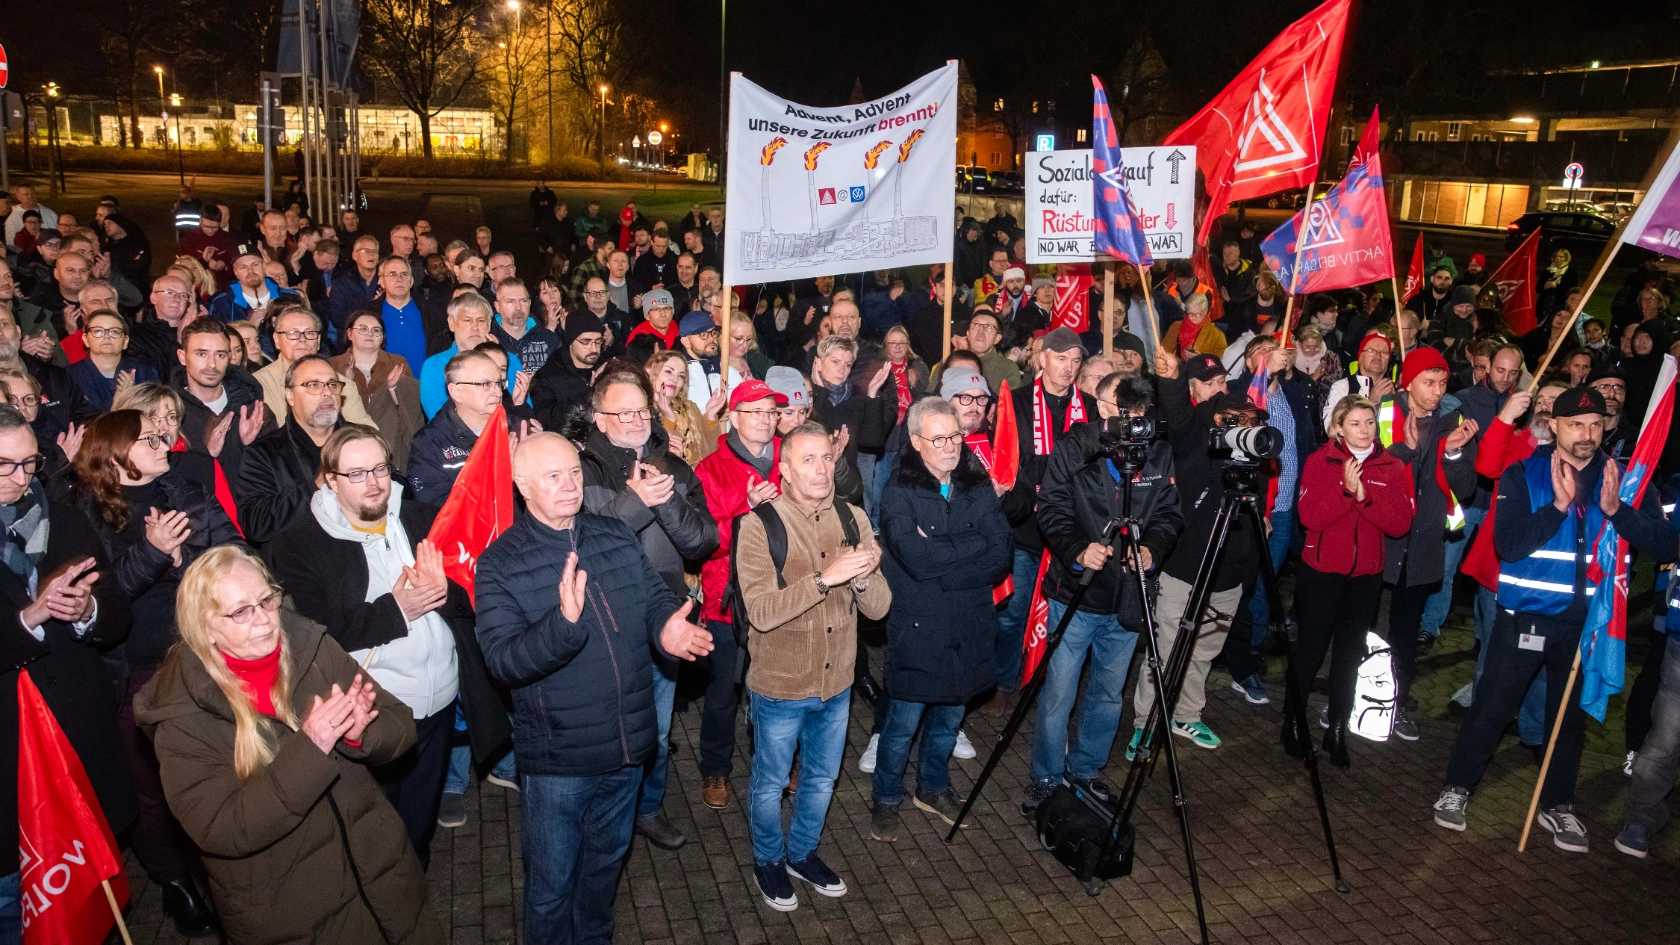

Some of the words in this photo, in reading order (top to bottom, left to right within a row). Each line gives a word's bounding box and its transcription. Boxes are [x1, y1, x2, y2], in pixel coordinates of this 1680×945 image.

[748, 117, 808, 138] unsere
[810, 124, 876, 140] Zukunft
[877, 101, 939, 132] brennt!
[784, 104, 852, 124] Advent,
[854, 92, 911, 121] Advent
[1039, 187, 1077, 207] dafür:
[1039, 241, 1055, 253] NO
[1056, 240, 1080, 254] WAR
